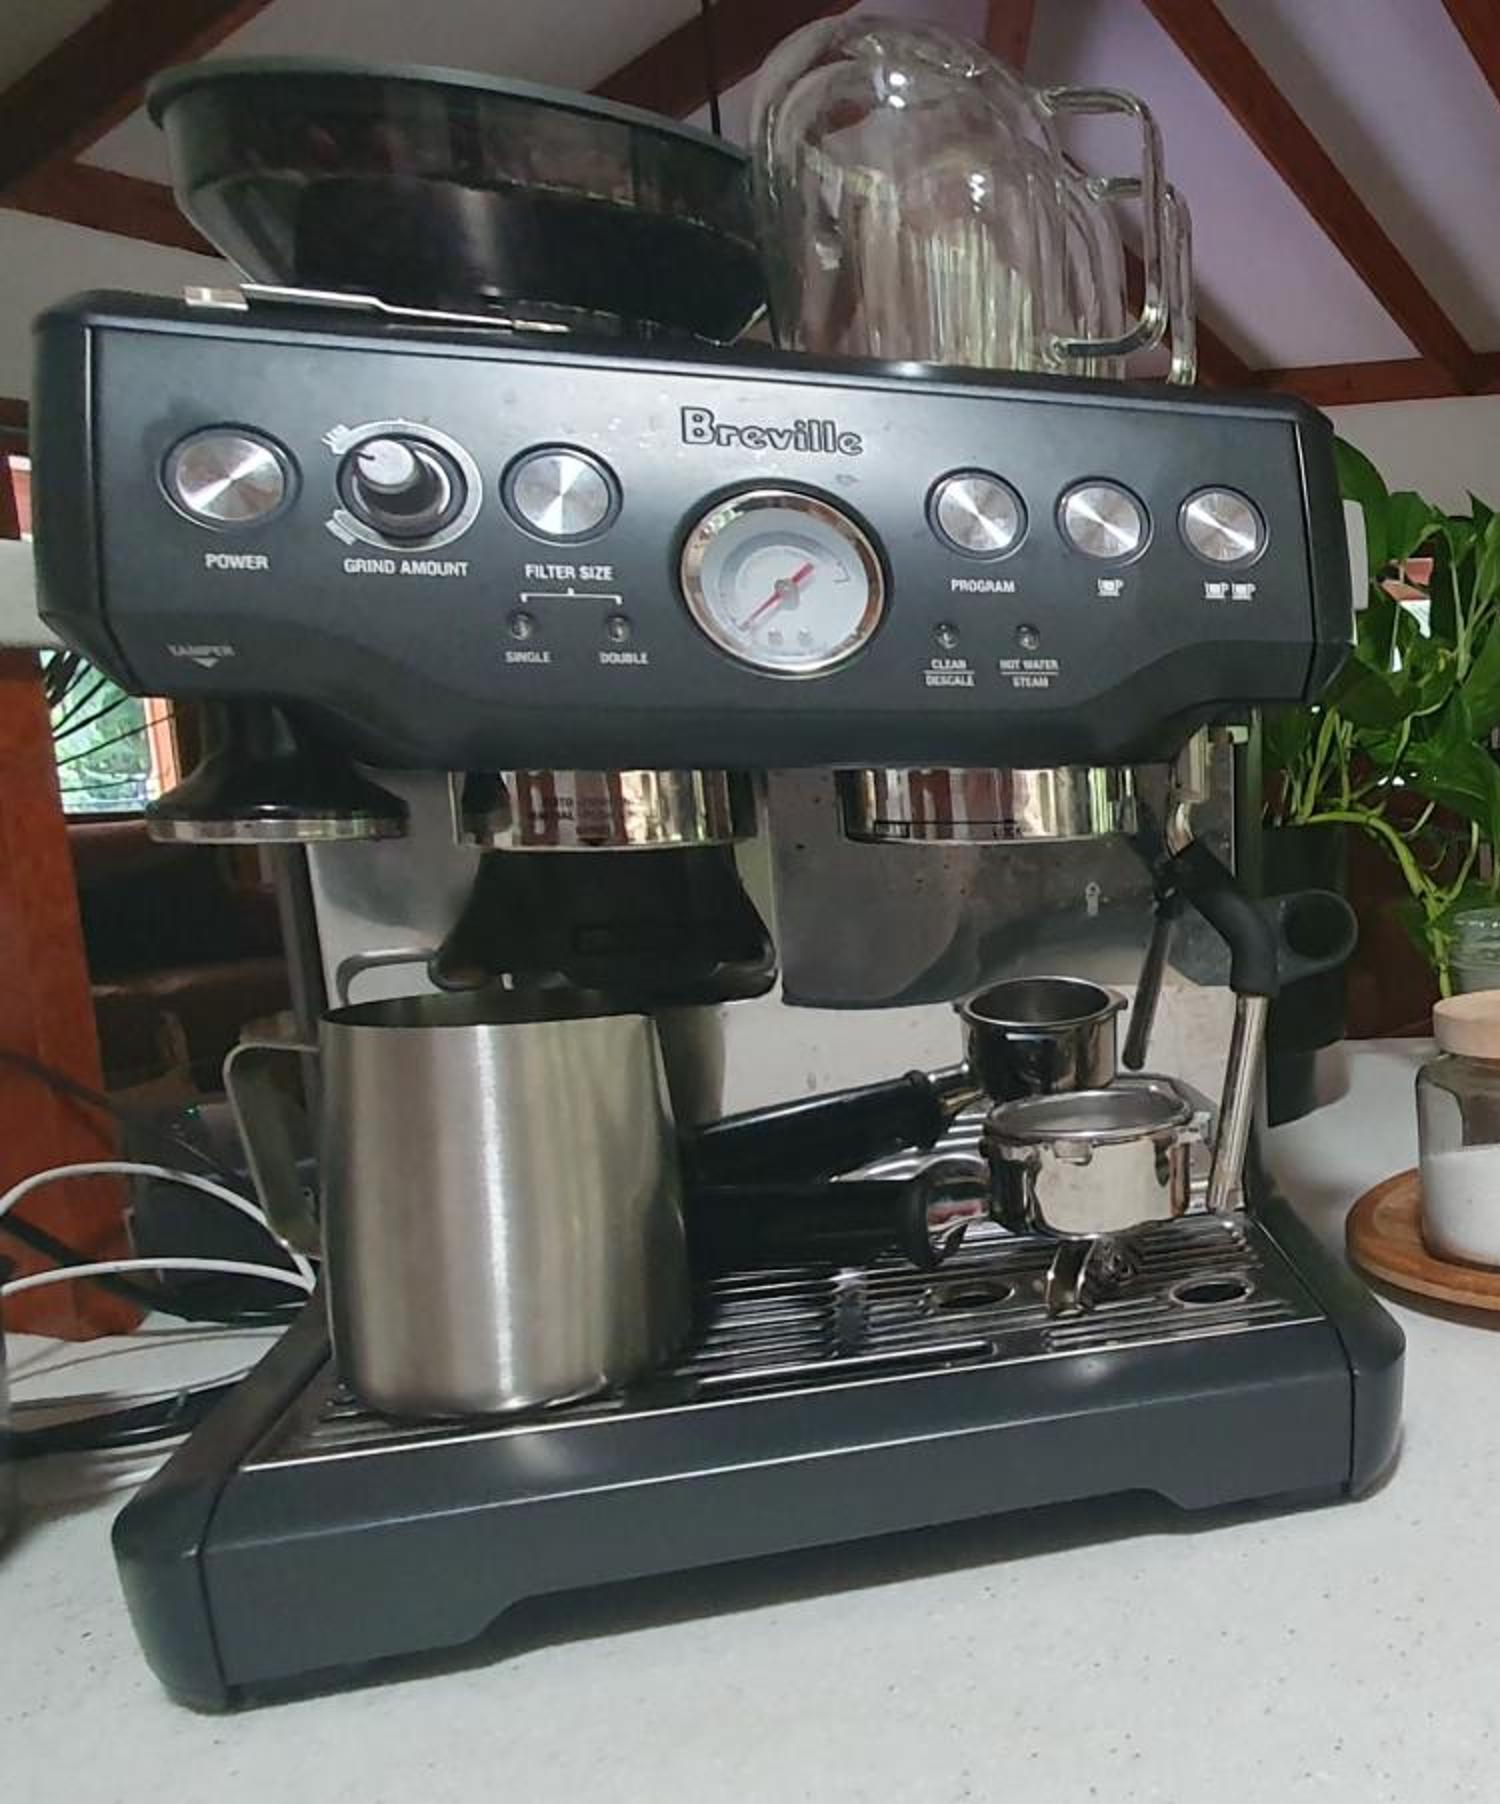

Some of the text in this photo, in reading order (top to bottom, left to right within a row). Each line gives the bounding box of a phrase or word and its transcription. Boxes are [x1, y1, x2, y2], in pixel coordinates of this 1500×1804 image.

[681, 406, 864, 456] Breville
[204, 553, 269, 570] POWER
[343, 558, 469, 577] GRIND AMOUNT
[525, 564, 614, 581] FILTER SIZE
[950, 578, 1016, 594] PROGRAM
[505, 651, 551, 664] SINGLE
[600, 652, 649, 665] DOUBLE
[930, 658, 968, 670] CLEAN
[1012, 676, 1049, 689] STEAM
